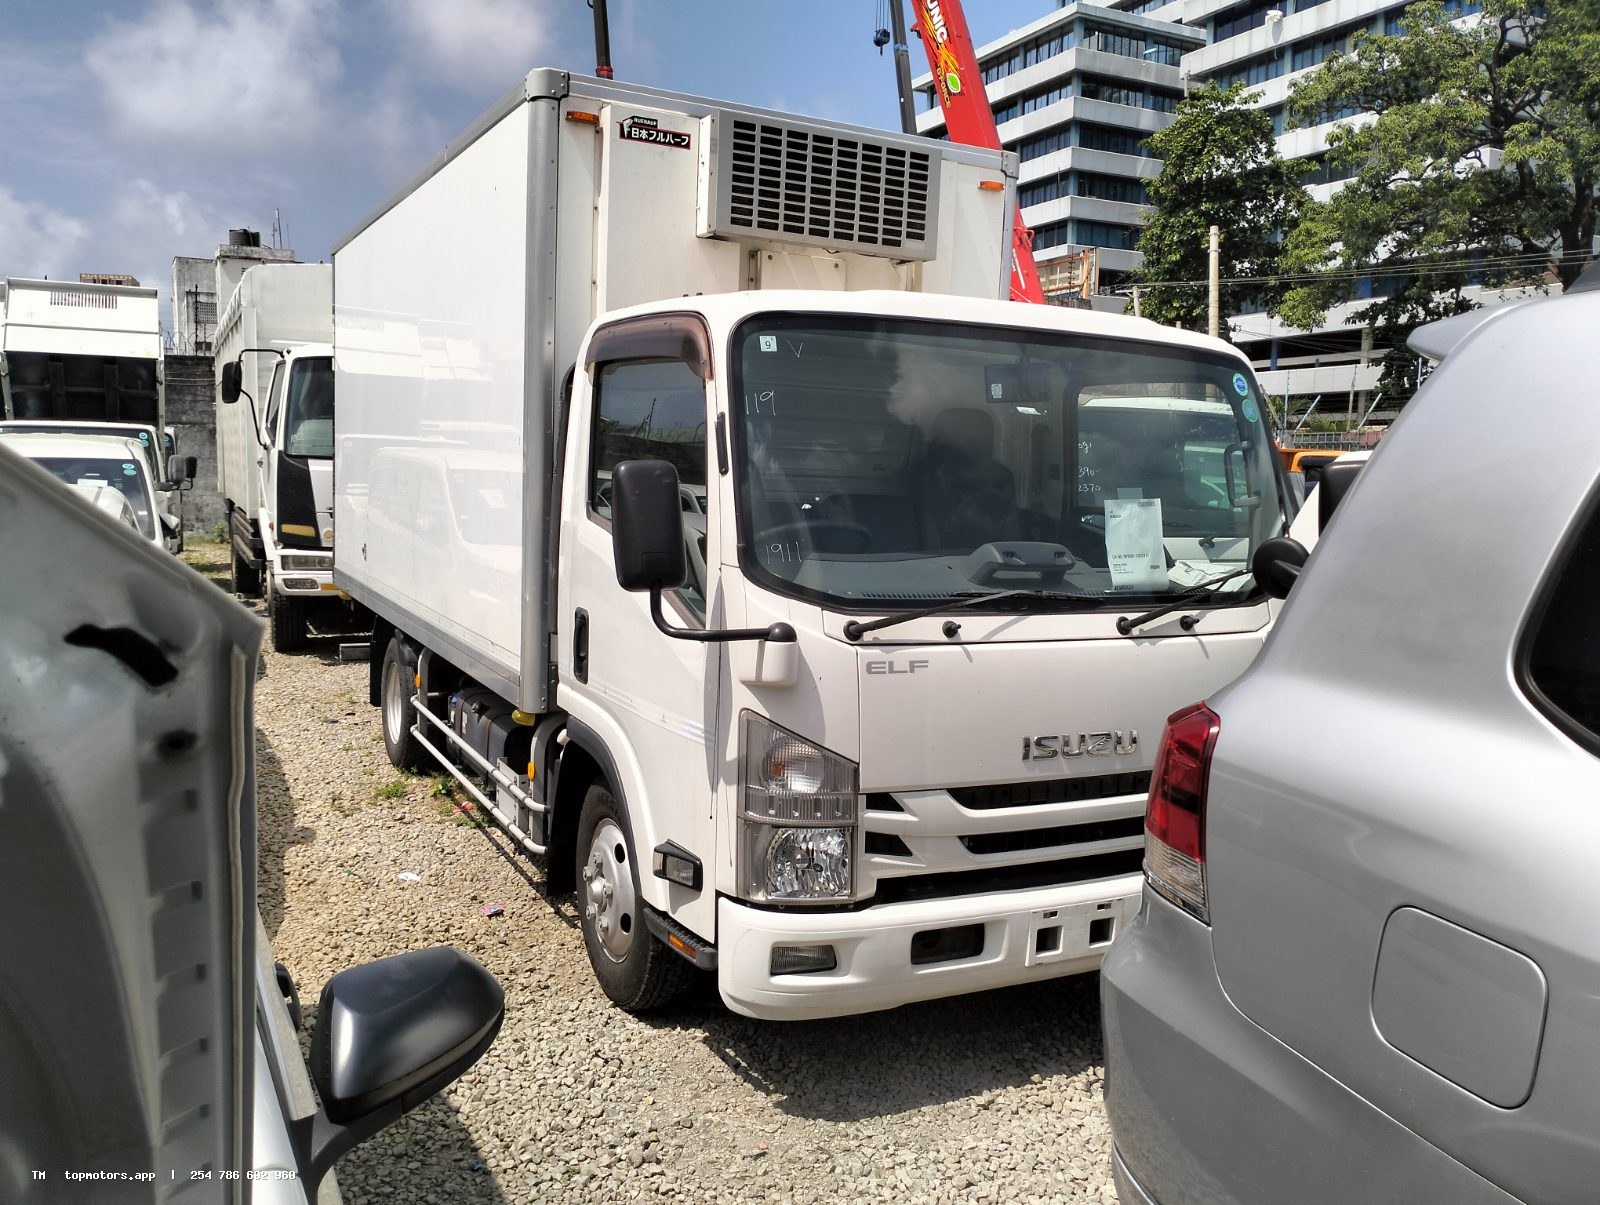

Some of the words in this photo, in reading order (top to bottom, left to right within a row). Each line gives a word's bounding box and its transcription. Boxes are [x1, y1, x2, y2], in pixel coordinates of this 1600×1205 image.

[631, 127, 689, 145] 日本フルハーフ
[865, 659, 929, 675] ELF
[1022, 729, 1138, 761] ISUZU
